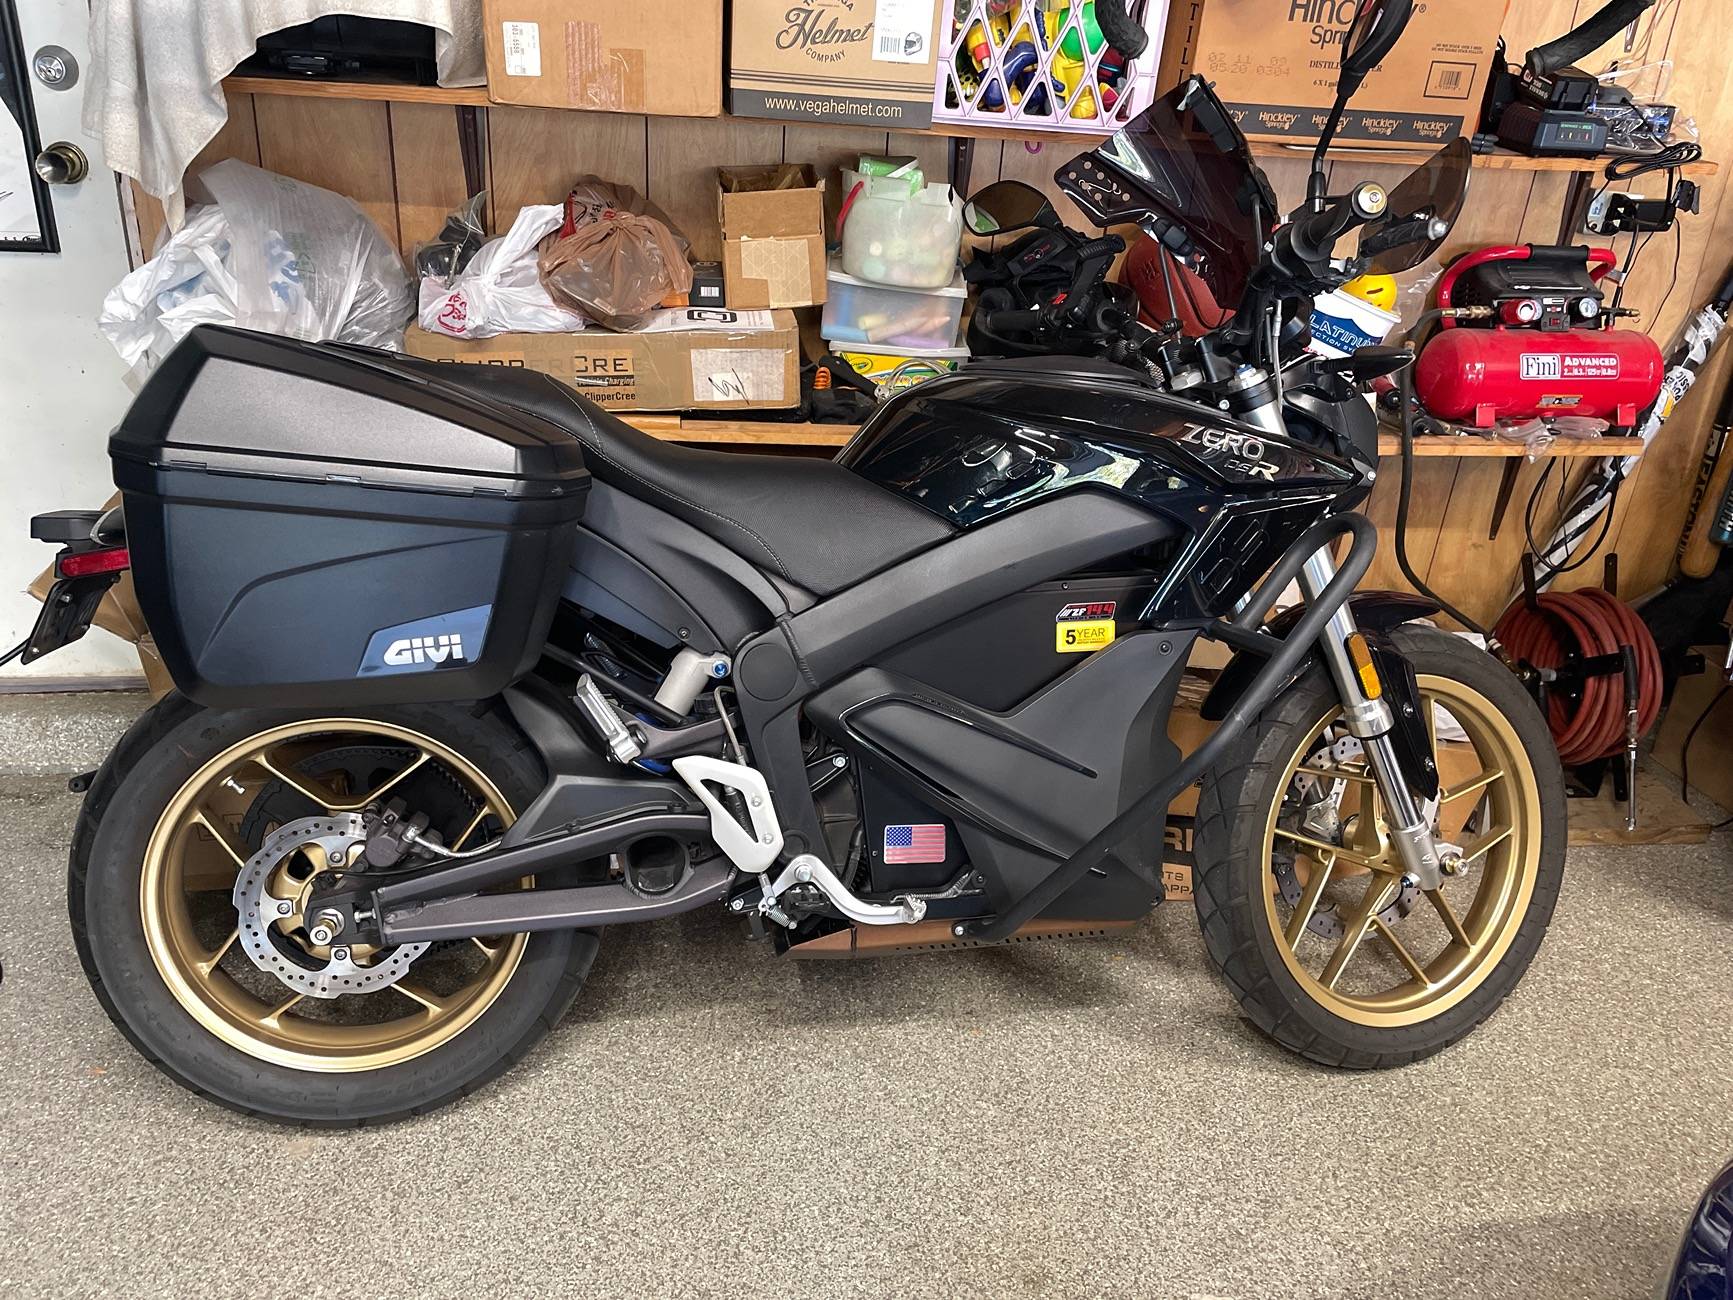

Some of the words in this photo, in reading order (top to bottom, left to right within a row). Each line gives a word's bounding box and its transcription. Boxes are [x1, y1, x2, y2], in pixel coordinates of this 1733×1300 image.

[775, 7, 874, 50] Helmet
[1310, 24, 1348, 50] Spri
[805, 47, 847, 63] COMPANY
[1309, 60, 1341, 70] DISTILL
[764, 97, 902, 118] www.vegahelmet.com
[1259, 112, 1297, 125] Hinckley
[1265, 121, 1286, 129] Springs
[1361, 117, 1399, 131] Hinckley
[1413, 120, 1450, 133] Hinckley
[1368, 127, 1387, 135] Springs
[1419, 129, 1437, 137] Springs
[1309, 314, 1374, 348] LATINU
[1311, 329, 1341, 347] ECTION
[1525, 357, 1556, 376] Fini
[1563, 356, 1617, 366] ADVANCED
[1180, 422, 1265, 461] ZERO
[1224, 459, 1280, 482] DSR
[1065, 629, 1077, 645] 5
[1077, 628, 1105, 638] YEAR
[383, 633, 464, 666] GIVI
